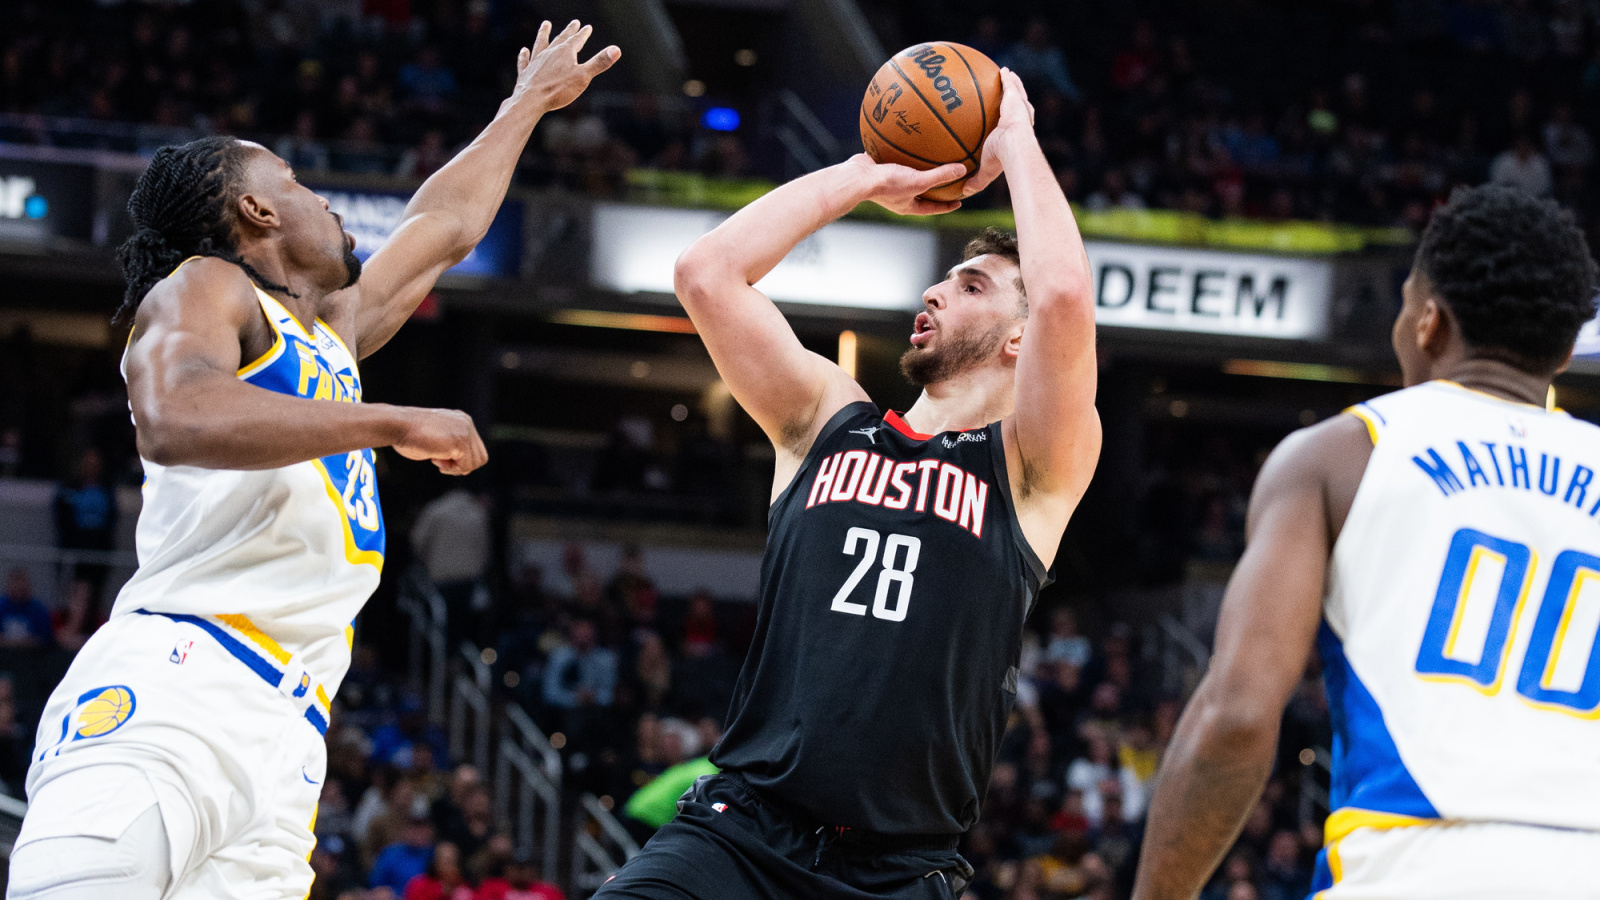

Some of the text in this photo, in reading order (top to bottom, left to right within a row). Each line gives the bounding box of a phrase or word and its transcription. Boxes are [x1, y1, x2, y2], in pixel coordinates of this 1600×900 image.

[905, 43, 963, 114] Wilson
[342, 449, 380, 532] 23
[806, 449, 989, 538] HOUSTON
[830, 526, 922, 622] 28
[1414, 527, 1600, 721] 00
